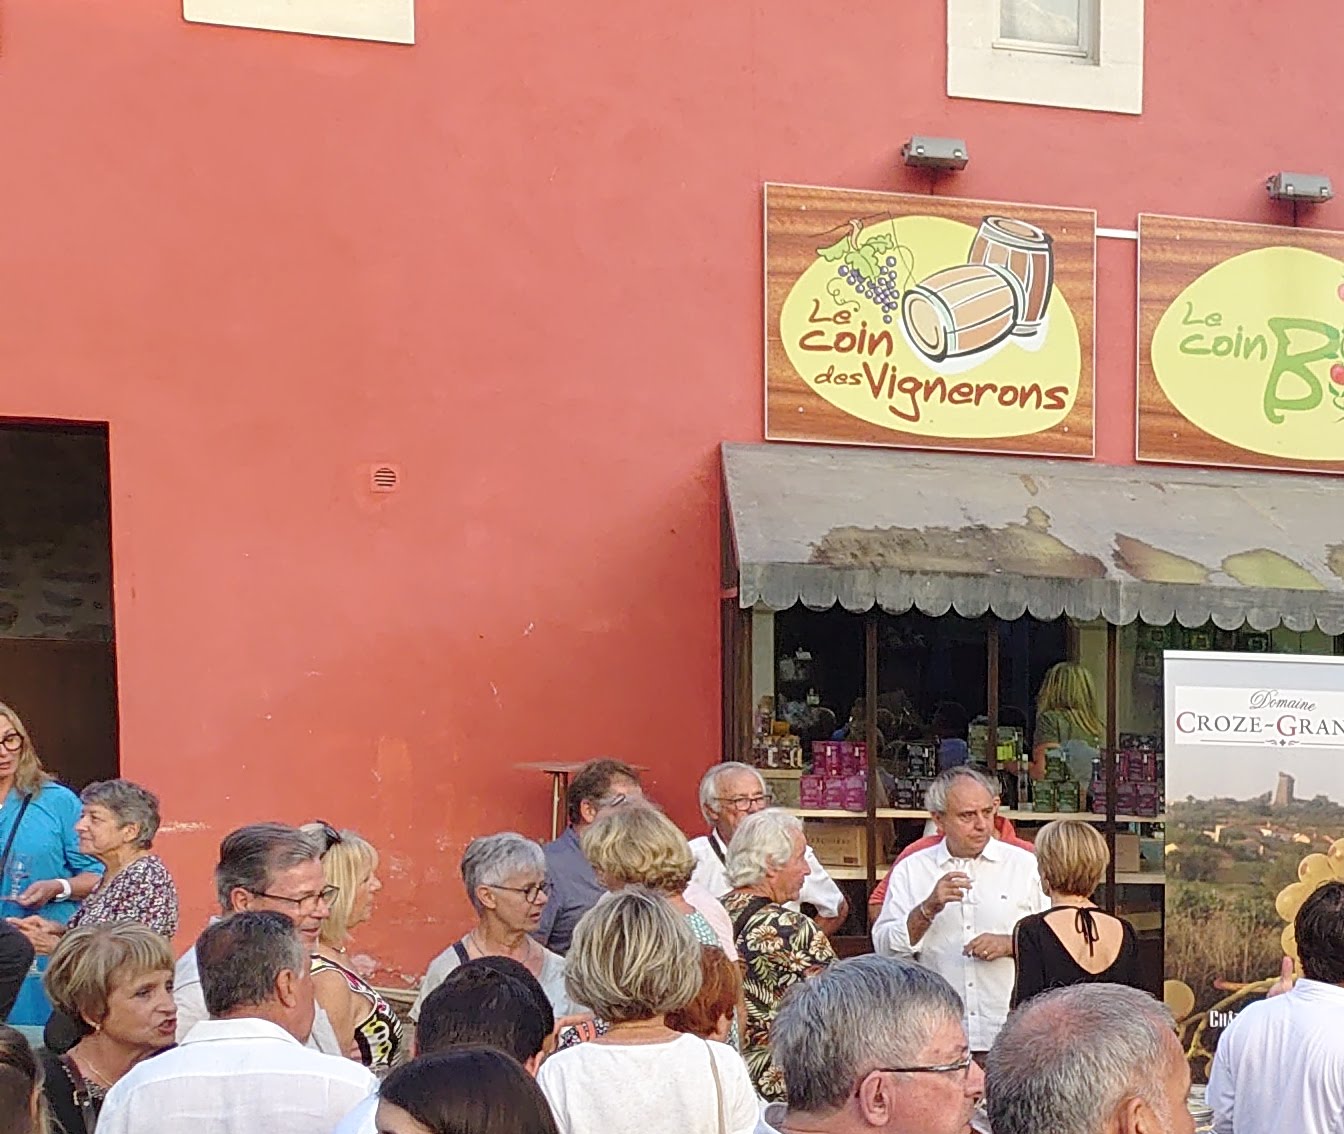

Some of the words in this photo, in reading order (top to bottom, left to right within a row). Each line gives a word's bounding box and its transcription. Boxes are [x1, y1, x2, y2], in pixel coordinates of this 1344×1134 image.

[808, 298, 852, 326] Le
[1181, 301, 1222, 330] Le
[799, 326, 894, 356] coin
[1178, 333, 1269, 361] coin
[814, 366, 863, 387] des
[862, 361, 1069, 423] Vignerons
[1249, 689, 1317, 713] Domaine
